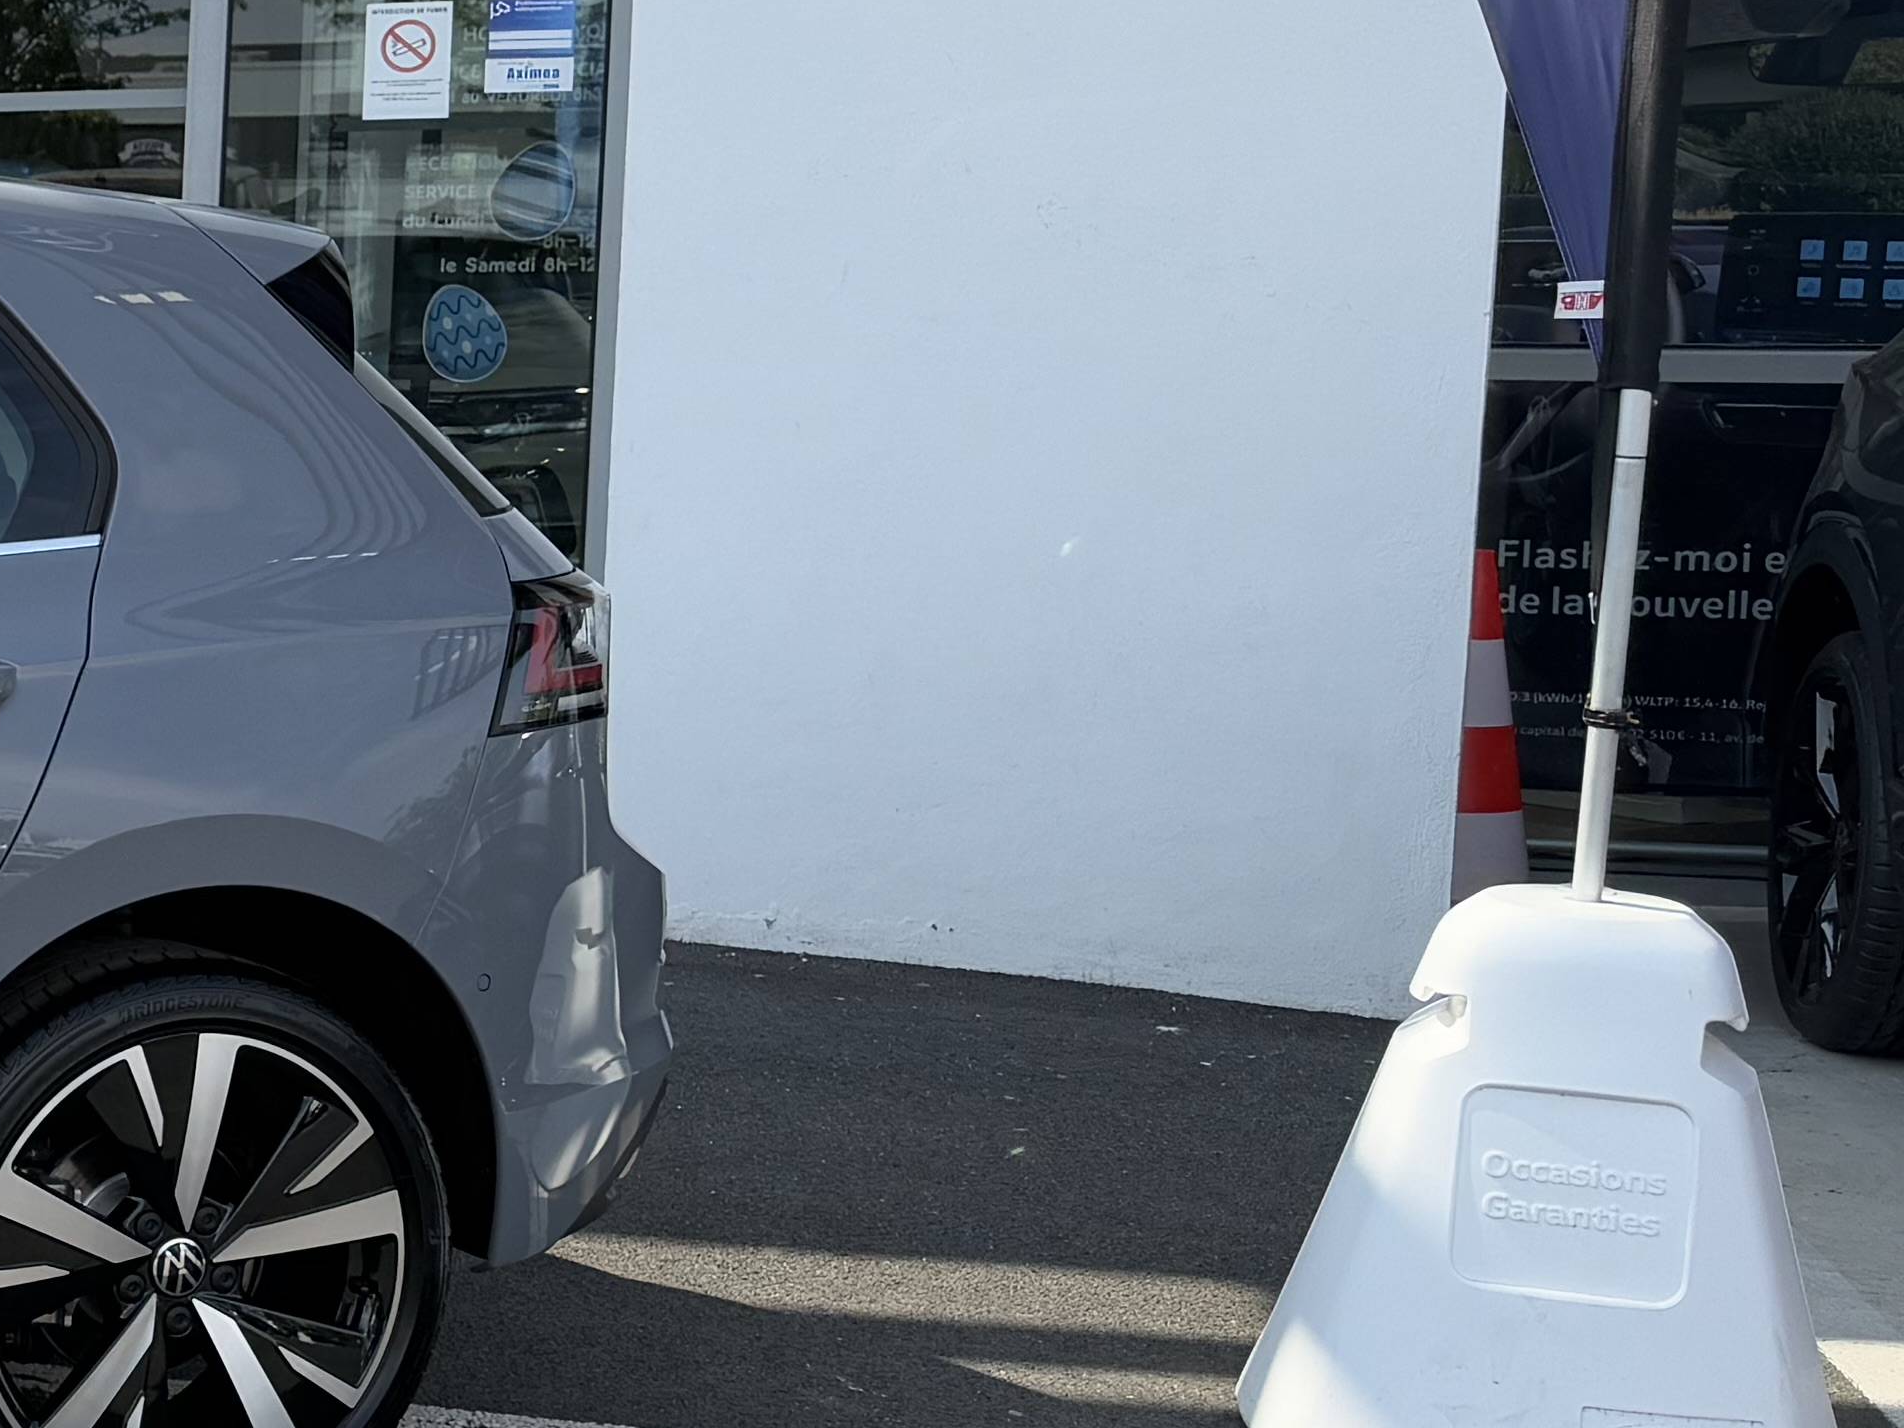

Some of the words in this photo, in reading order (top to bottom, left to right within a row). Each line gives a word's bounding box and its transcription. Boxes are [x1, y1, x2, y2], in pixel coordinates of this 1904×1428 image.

[403, 184, 479, 200] SERVICE
[440, 257, 457, 273] le
[464, 256, 536, 273] Samedi
[1631, 589, 1774, 620] ouvelle
[1480, 1148, 1667, 1196] Occasions
[1480, 1190, 1662, 1238] Garanties
